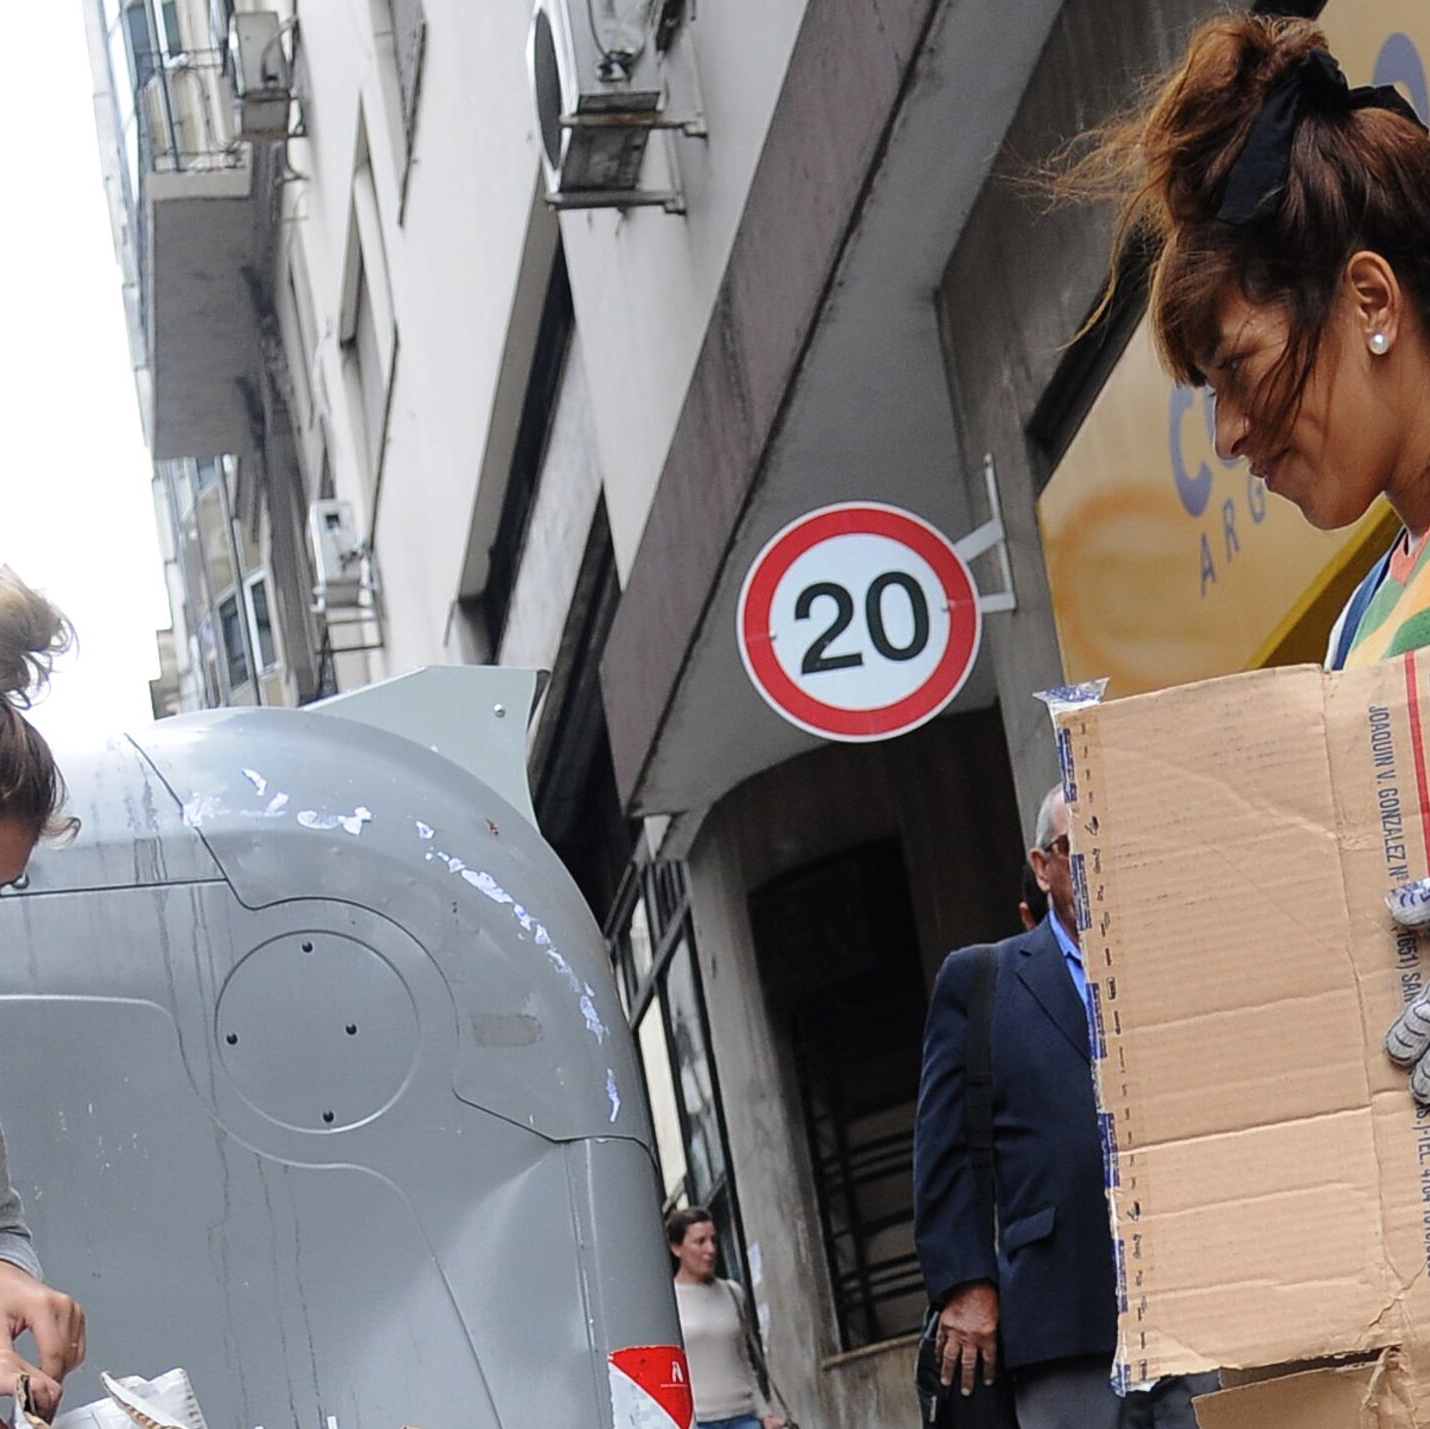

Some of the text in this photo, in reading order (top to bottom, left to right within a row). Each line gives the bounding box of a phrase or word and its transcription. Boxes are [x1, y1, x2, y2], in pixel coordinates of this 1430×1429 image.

[794, 570, 930, 675] 20
[1368, 706, 1394, 768] JOAQUIN
[1376, 769, 1397, 785] V.
[1378, 787, 1407, 863] GONZALEZ
